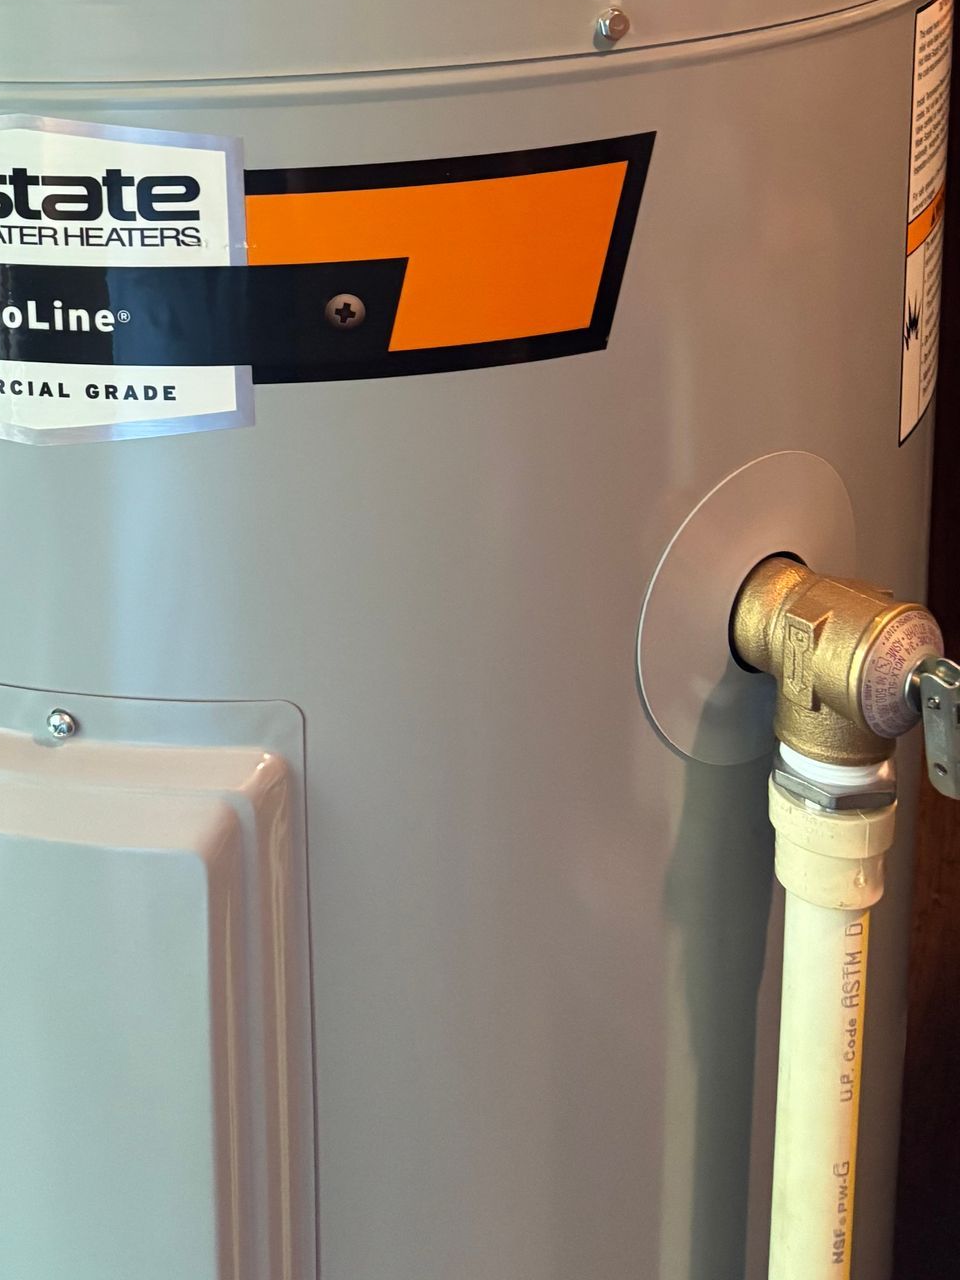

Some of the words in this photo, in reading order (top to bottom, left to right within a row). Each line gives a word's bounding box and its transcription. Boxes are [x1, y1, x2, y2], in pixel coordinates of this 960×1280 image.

[64, 223, 201, 248] HEATERS
[86, 383, 178, 401] GRADE
[841, 950, 863, 1009] ASTM
[842, 1017, 858, 1062] Code
